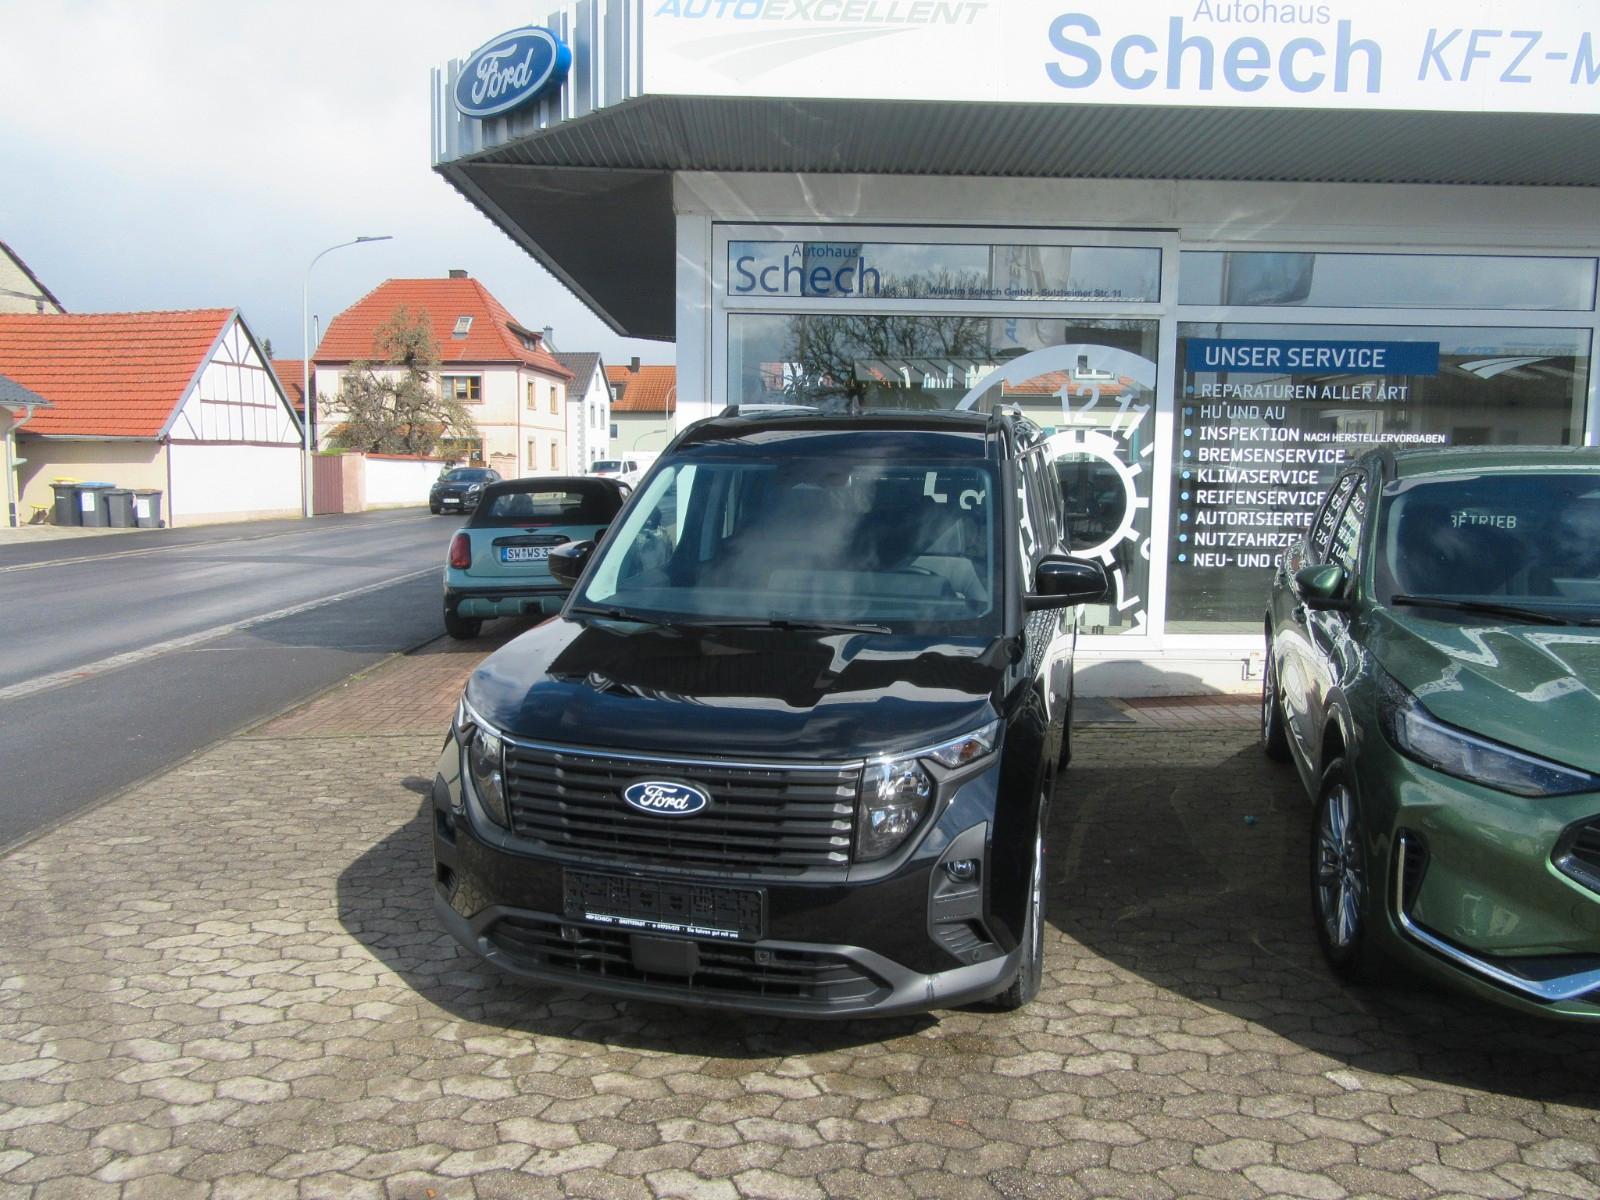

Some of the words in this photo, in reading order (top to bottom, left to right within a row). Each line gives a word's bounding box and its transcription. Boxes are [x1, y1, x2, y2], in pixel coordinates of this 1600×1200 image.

[1192, 0, 1331, 25] Autohaus
[1044, 12, 1383, 94] Schech
[471, 43, 534, 105] Ford
[791, 244, 858, 258] Autohaus
[735, 255, 880, 294] Schech
[928, 287, 966, 296] Wilhelm
[968, 287, 1002, 297] Schech
[1004, 287, 1033, 297] GmbH
[1040, 287, 1092, 297] Sulzheimer
[1205, 347, 1281, 367] UNSER
[1287, 348, 1386, 368] SERVICE
[1201, 383, 1317, 399] REPARATUREN
[1321, 385, 1371, 400] ALLER
[1376, 385, 1408, 400] ART
[1052, 384, 1100, 425] 12
[1227, 405, 1260, 420] UND
[1264, 406, 1285, 420] AU
[1199, 426, 1300, 442] INSPEKTION
[1303, 433, 1330, 443] NACH
[1332, 433, 1446, 444] HERSTELLERVORGABEN
[1198, 448, 1346, 464] BREMSENSERVICE
[1197, 469, 1319, 485] KLIMASERVICE
[1195, 511, 1314, 527] AUTORISIERTE
[1194, 532, 1302, 547] NUTZFAHRZE
[508, 548, 521, 559] SW
[527, 548, 540, 558] WS
[1193, 553, 1233, 567] NEU-
[1237, 553, 1270, 568] UND
[640, 784, 690, 810] Ford
